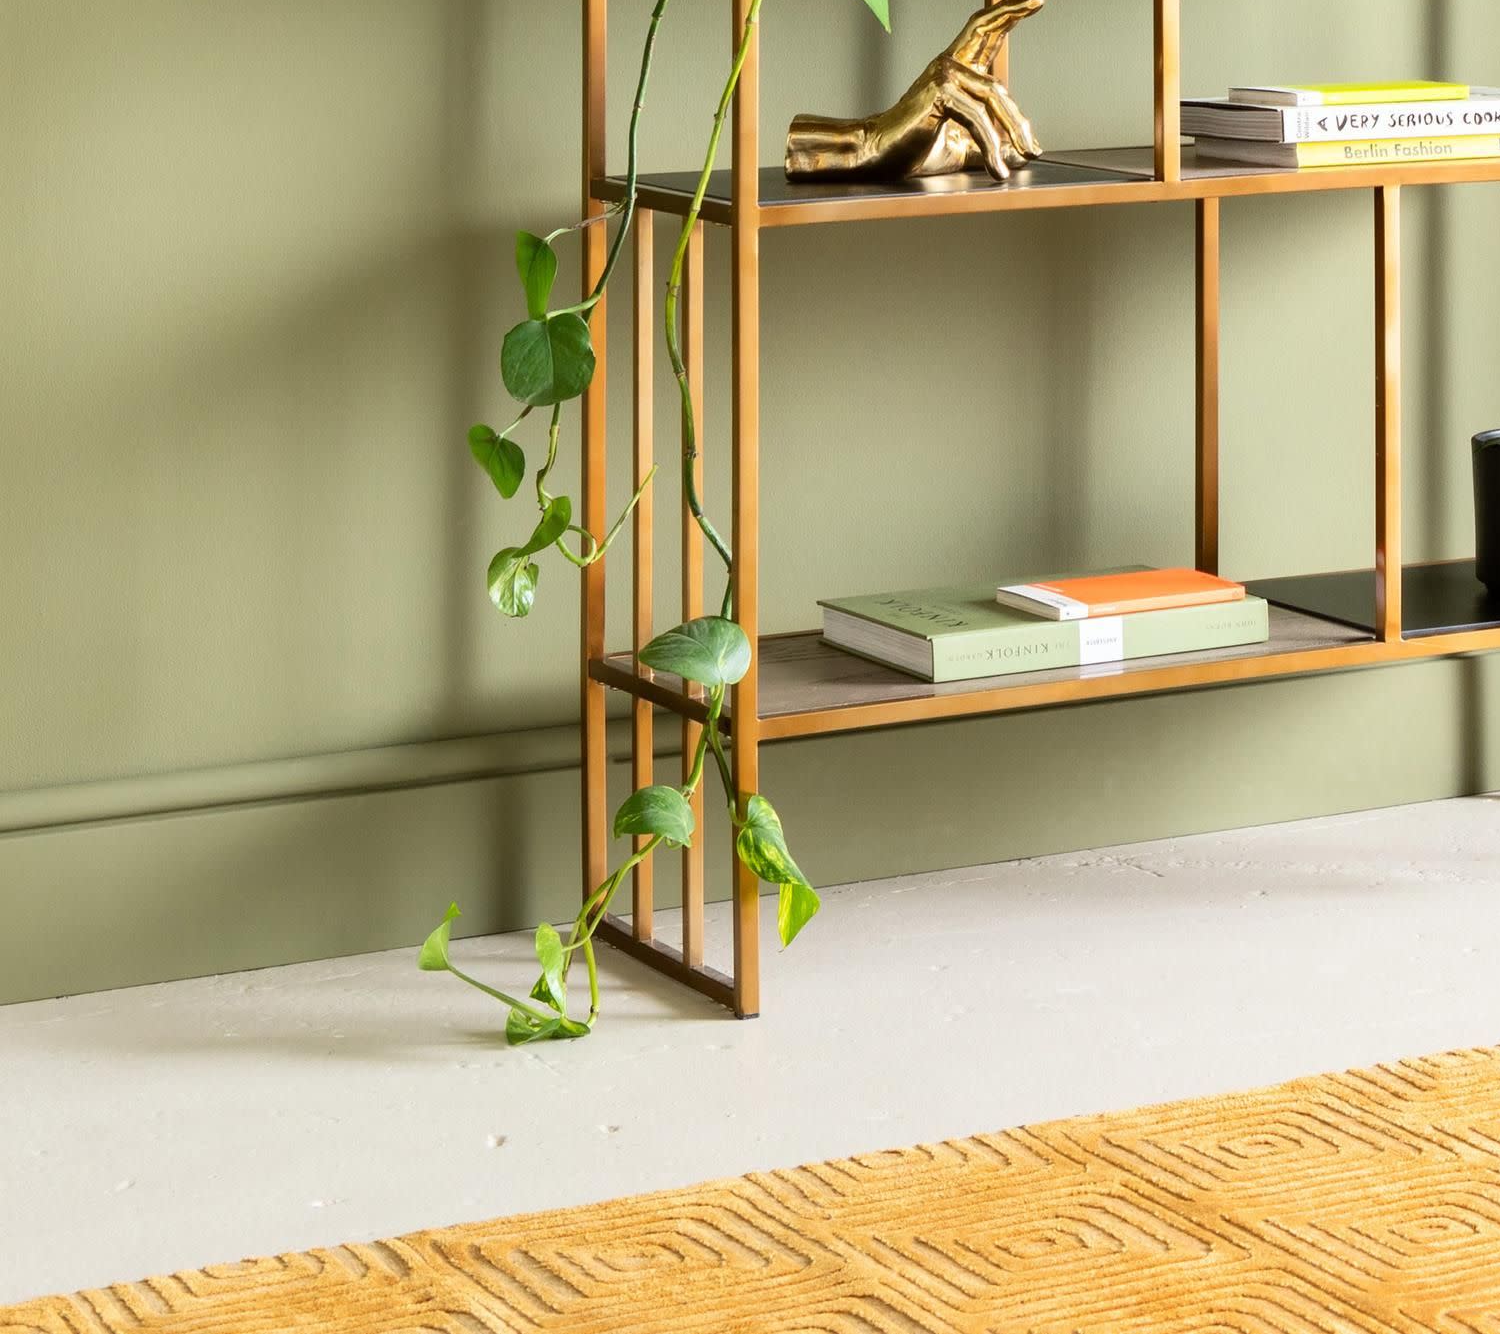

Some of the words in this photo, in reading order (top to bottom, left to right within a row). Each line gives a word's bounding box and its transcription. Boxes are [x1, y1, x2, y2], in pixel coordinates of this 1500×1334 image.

[1317, 116, 1328, 132] A
[1336, 113, 1380, 132] VERY
[1388, 111, 1454, 128] SERIOUS
[1344, 143, 1389, 159] Berlin
[1394, 141, 1453, 156] Fashion
[985, 642, 1049, 661] KINFOLK
